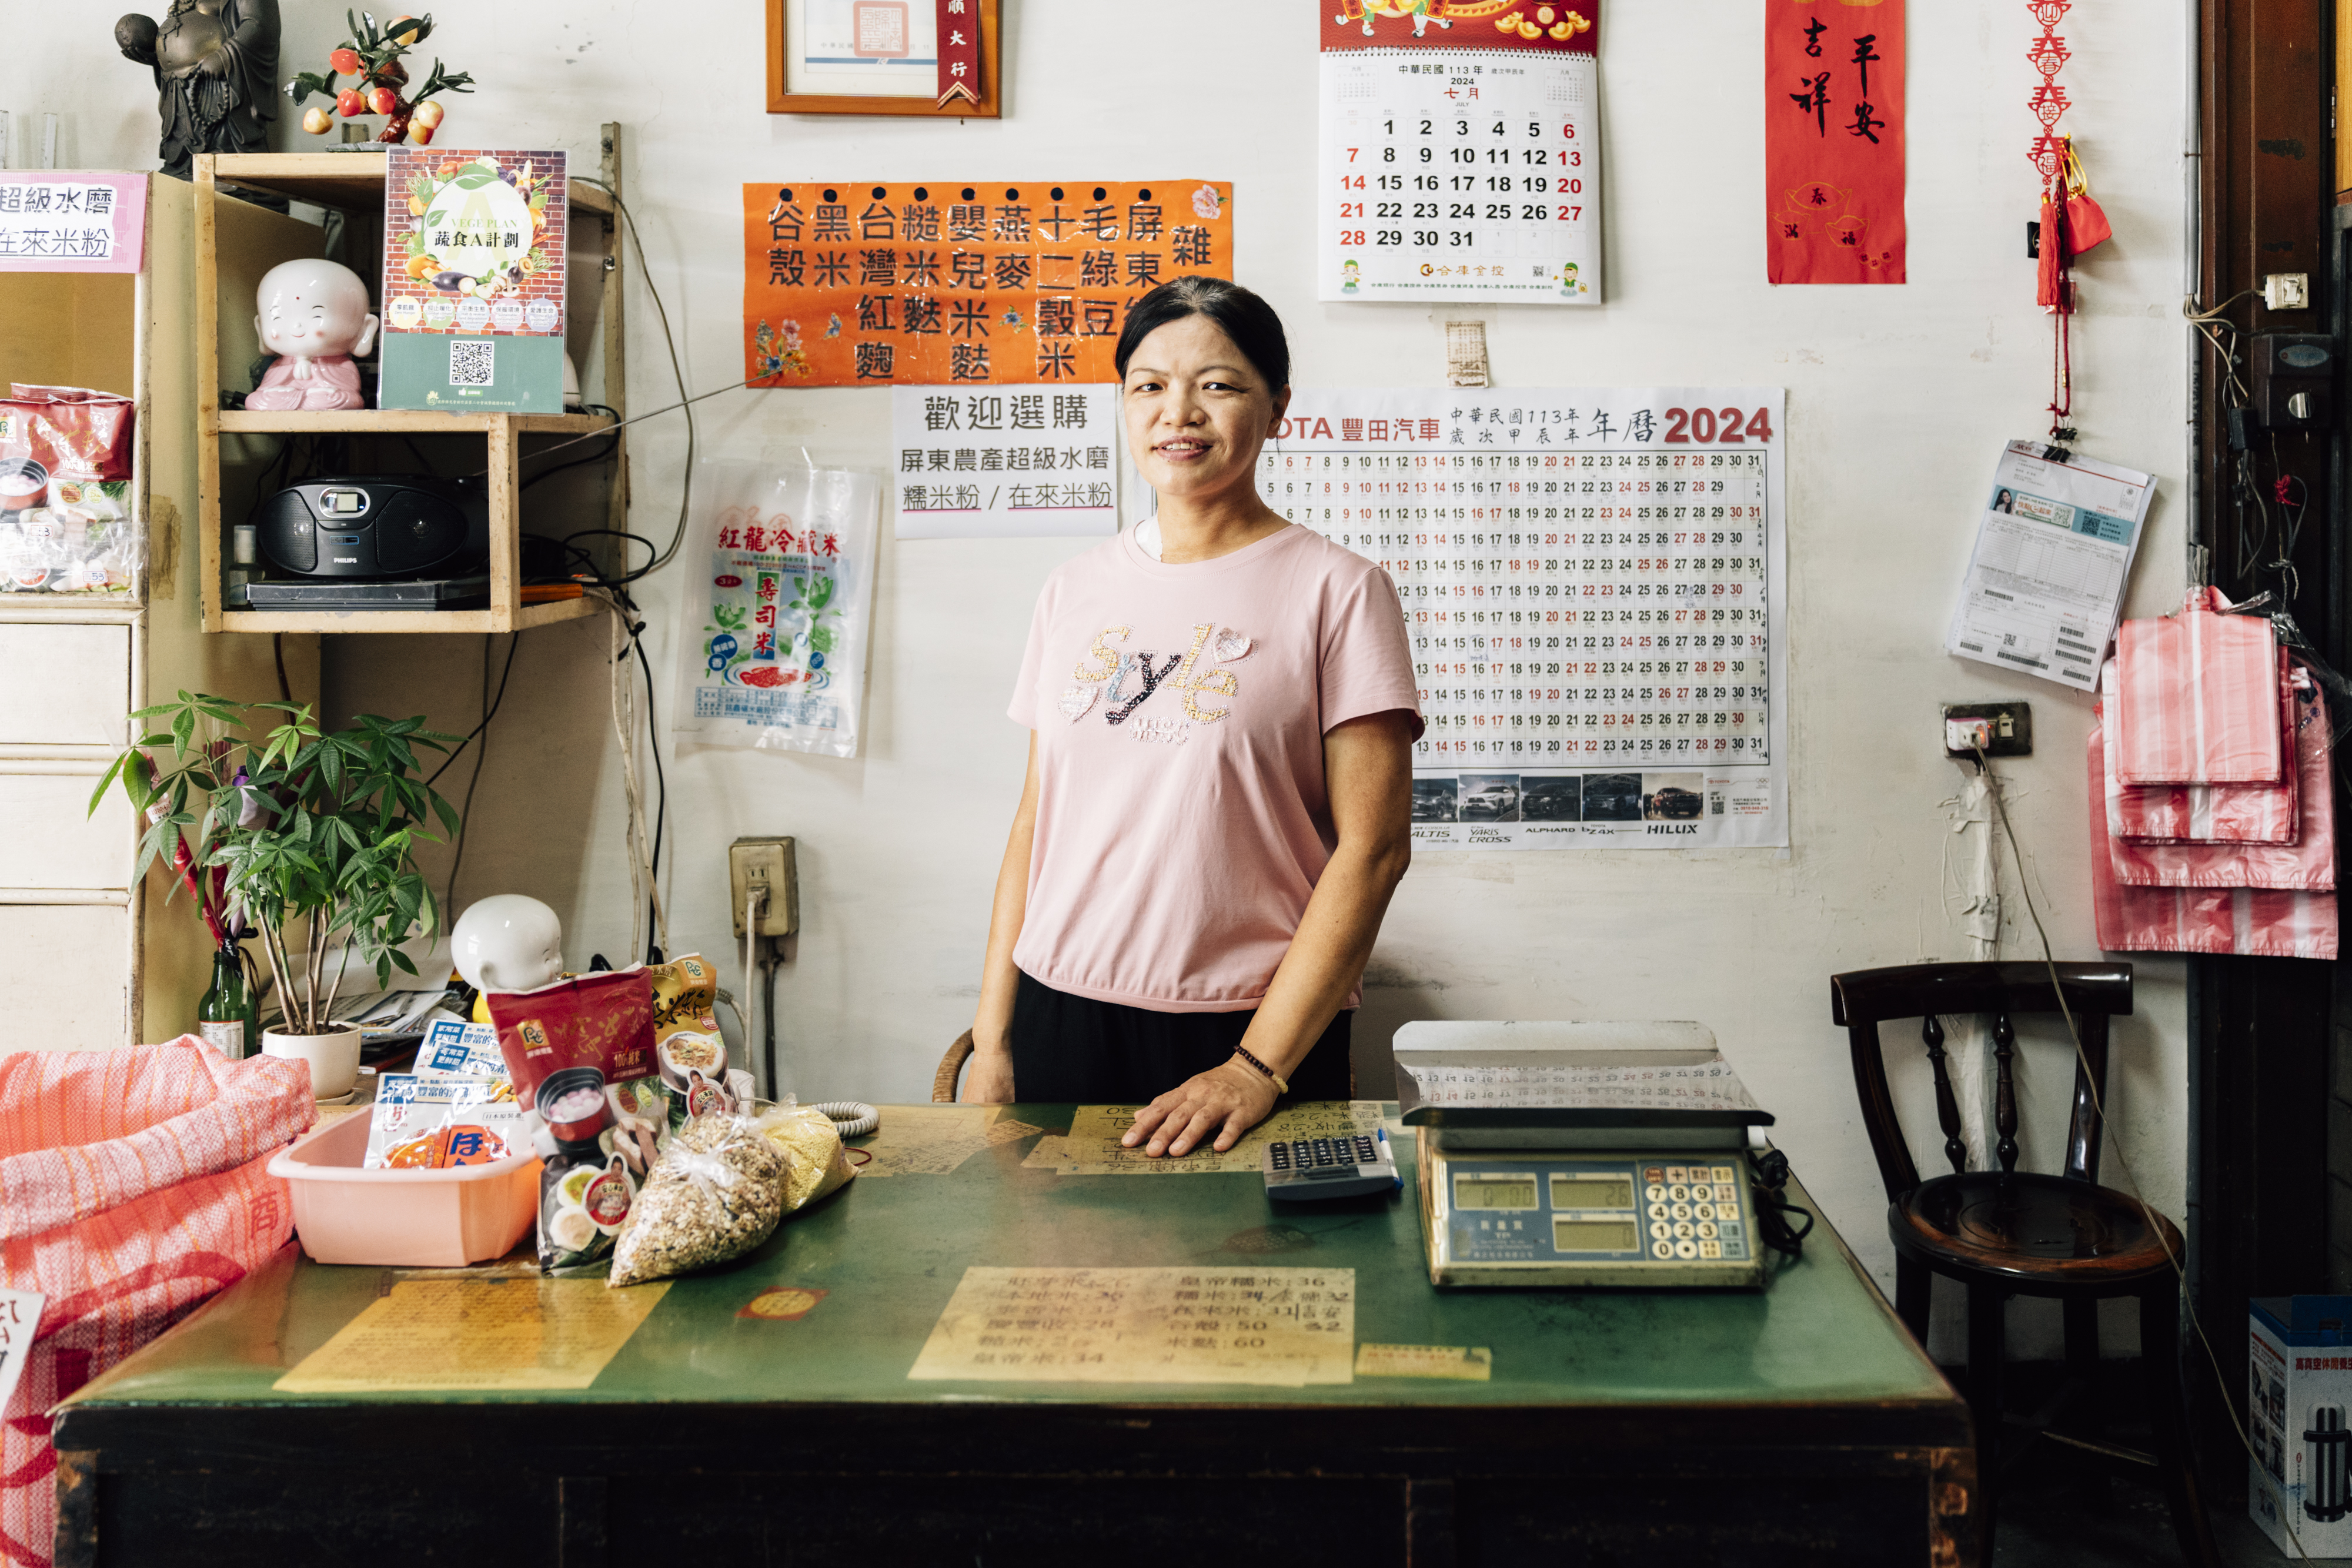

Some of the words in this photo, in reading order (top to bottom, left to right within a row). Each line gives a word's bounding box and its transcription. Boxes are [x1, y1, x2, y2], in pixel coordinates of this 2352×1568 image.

[1399, 65, 1444, 75] 中華民國
[1449, 66, 1469, 74] 113
[1474, 65, 1483, 75] 年
[1789, 17, 1831, 138] 吉祥
[1451, 77, 1475, 85] 2024
[1845, 34, 1885, 144] 平安
[1444, 88, 1479, 100] 七月
[1385, 120, 1392, 134] 1
[1421, 121, 1431, 134] 2
[1457, 121, 1468, 135] 3
[1492, 122, 1505, 136] 4
[1529, 123, 1540, 137] 5
[1563, 124, 1575, 139] 6
[1348, 148, 1358, 162] 7
[1384, 148, 1395, 162] 8
[1421, 148, 1431, 162] 9
[1451, 148, 1475, 163] 10
[1487, 149, 1508, 163] 11
[1523, 150, 1546, 165] 12
[1558, 151, 1581, 166] 13
[1341, 176, 1365, 189] 14
[1378, 175, 1402, 189] 15
[1414, 176, 1438, 190] 16
[1451, 176, 1475, 190] 17
[1487, 177, 1511, 191] 18
[1523, 178, 1546, 192] 19
[1558, 178, 1581, 193] 20
[0, 186, 112, 214] 超級水磨
[1811, 188, 1827, 205] 春
[1341, 203, 1362, 217] 21
[1377, 203, 1402, 217] 22
[1414, 203, 1438, 218] 23
[1450, 204, 1475, 218] 24
[1486, 205, 1511, 219] 25
[1522, 205, 1547, 219] 26
[1558, 206, 1582, 220] 27
[452, 219, 483, 228] VEGE
[487, 219, 517, 229] PLAN
[435, 231, 519, 248] 蔬食A計劃
[769, 203, 807, 288] 谷殼
[813, 203, 852, 287] 黑米
[993, 204, 1032, 290] 燕麥
[1341, 230, 1365, 245] 28
[1377, 230, 1402, 245] 29
[1414, 231, 1438, 246] 30
[1450, 232, 1472, 246] 31
[1081, 203, 1118, 337] 毛綠豆
[1436, 265, 1504, 276] 合庫金控
[1037, 204, 1077, 377] 十二穀米
[925, 394, 1088, 431] 歡迎選購
[1342, 417, 1441, 442] 豐田汽車
[1587, 407, 1657, 444] 年曆
[1664, 407, 1773, 444] 2024
[901, 446, 1109, 472] 屏東農產超級水磨
[1268, 456, 1274, 466] 5
[1287, 456, 1293, 466] 6
[1305, 456, 1311, 466] 7
[1324, 456, 1331, 466] 8
[1343, 456, 1349, 466] 9
[1359, 456, 1371, 466] 10
[1710, 456, 1723, 466] 29
[1729, 456, 1741, 466] 30
[1748, 456, 1759, 466] 31
[903, 484, 980, 510] 糯米粉
[1008, 482, 1112, 508] 在來米粉
[718, 526, 841, 557] 紅龍冷藏米
[92, 572, 105, 581] 53
[753, 577, 779, 656] 壽司米
[1647, 824, 1698, 834] HILUX
[1606, 1184, 1628, 1206] 26
[1652, 1188, 1661, 1199] 7
[1675, 1187, 1685, 1199] 8
[1698, 1187, 1708, 1199] 9
[1655, 1206, 1664, 1218] 4
[1678, 1206, 1687, 1218] 5
[1700, 1206, 1710, 1218] 6
[1657, 1225, 1665, 1236] 1
[1680, 1225, 1689, 1236] 2
[1703, 1225, 1712, 1236] 3
[1659, 1243, 1669, 1256] 0
